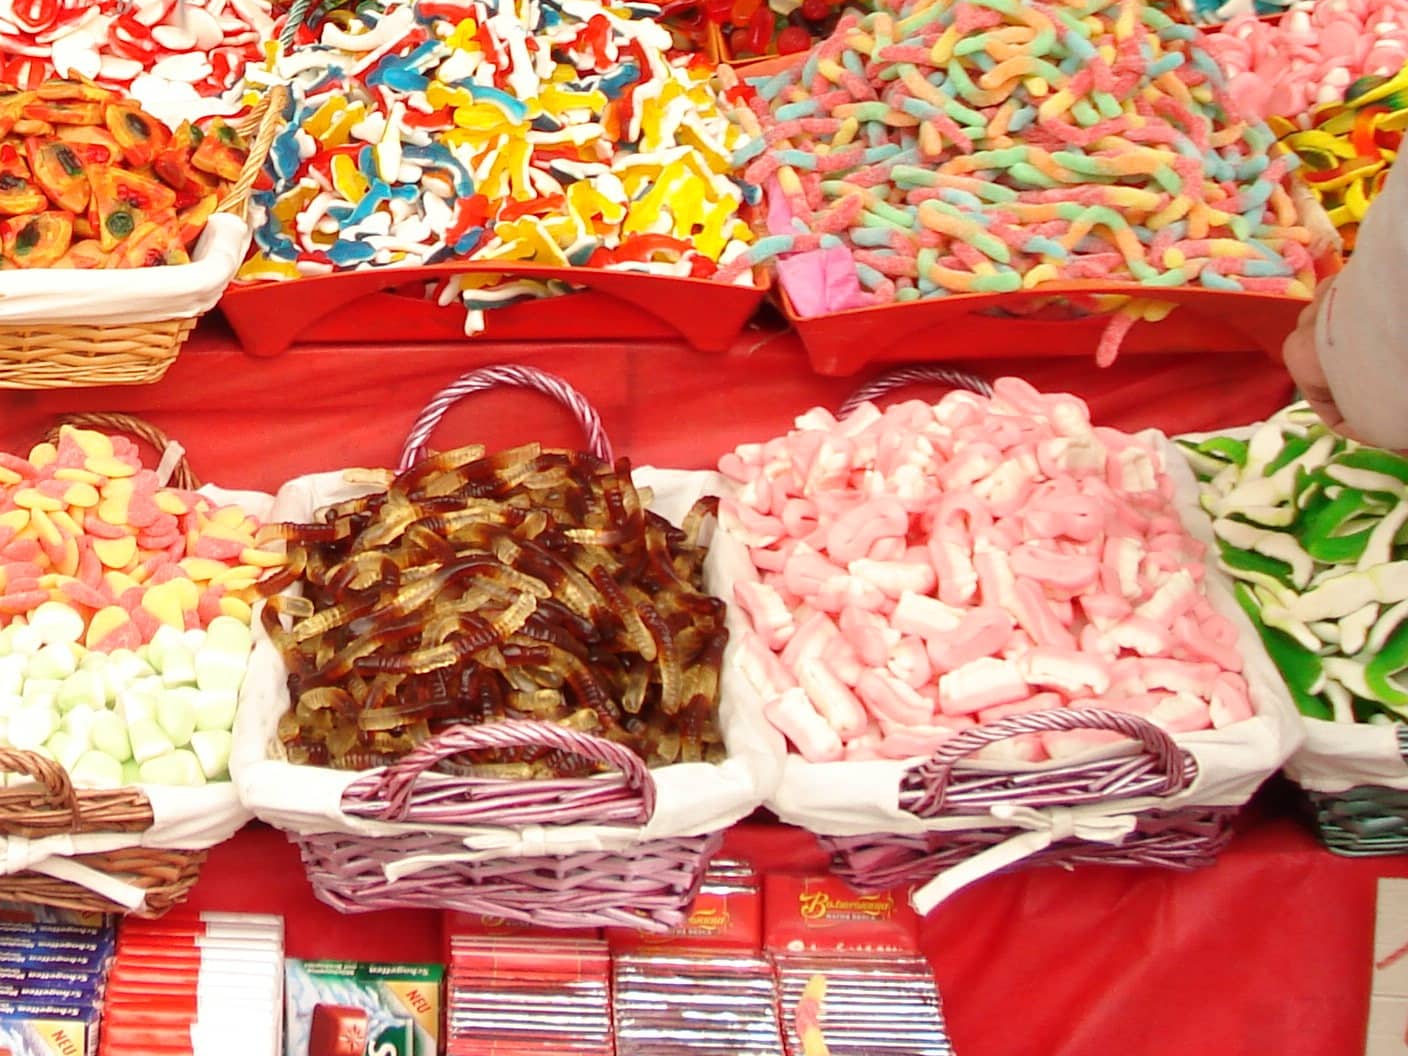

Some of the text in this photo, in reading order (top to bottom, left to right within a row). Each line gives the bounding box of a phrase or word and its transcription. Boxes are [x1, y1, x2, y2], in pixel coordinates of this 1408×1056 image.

[368, 965, 429, 977] Schogetten
[28, 972, 88, 983] Schogetten
[21, 988, 82, 1000] Schogetten
[406, 988, 432, 1014] NEU
[17, 1005, 79, 1016] Schogetten
[51, 1029, 78, 1056] NEU
